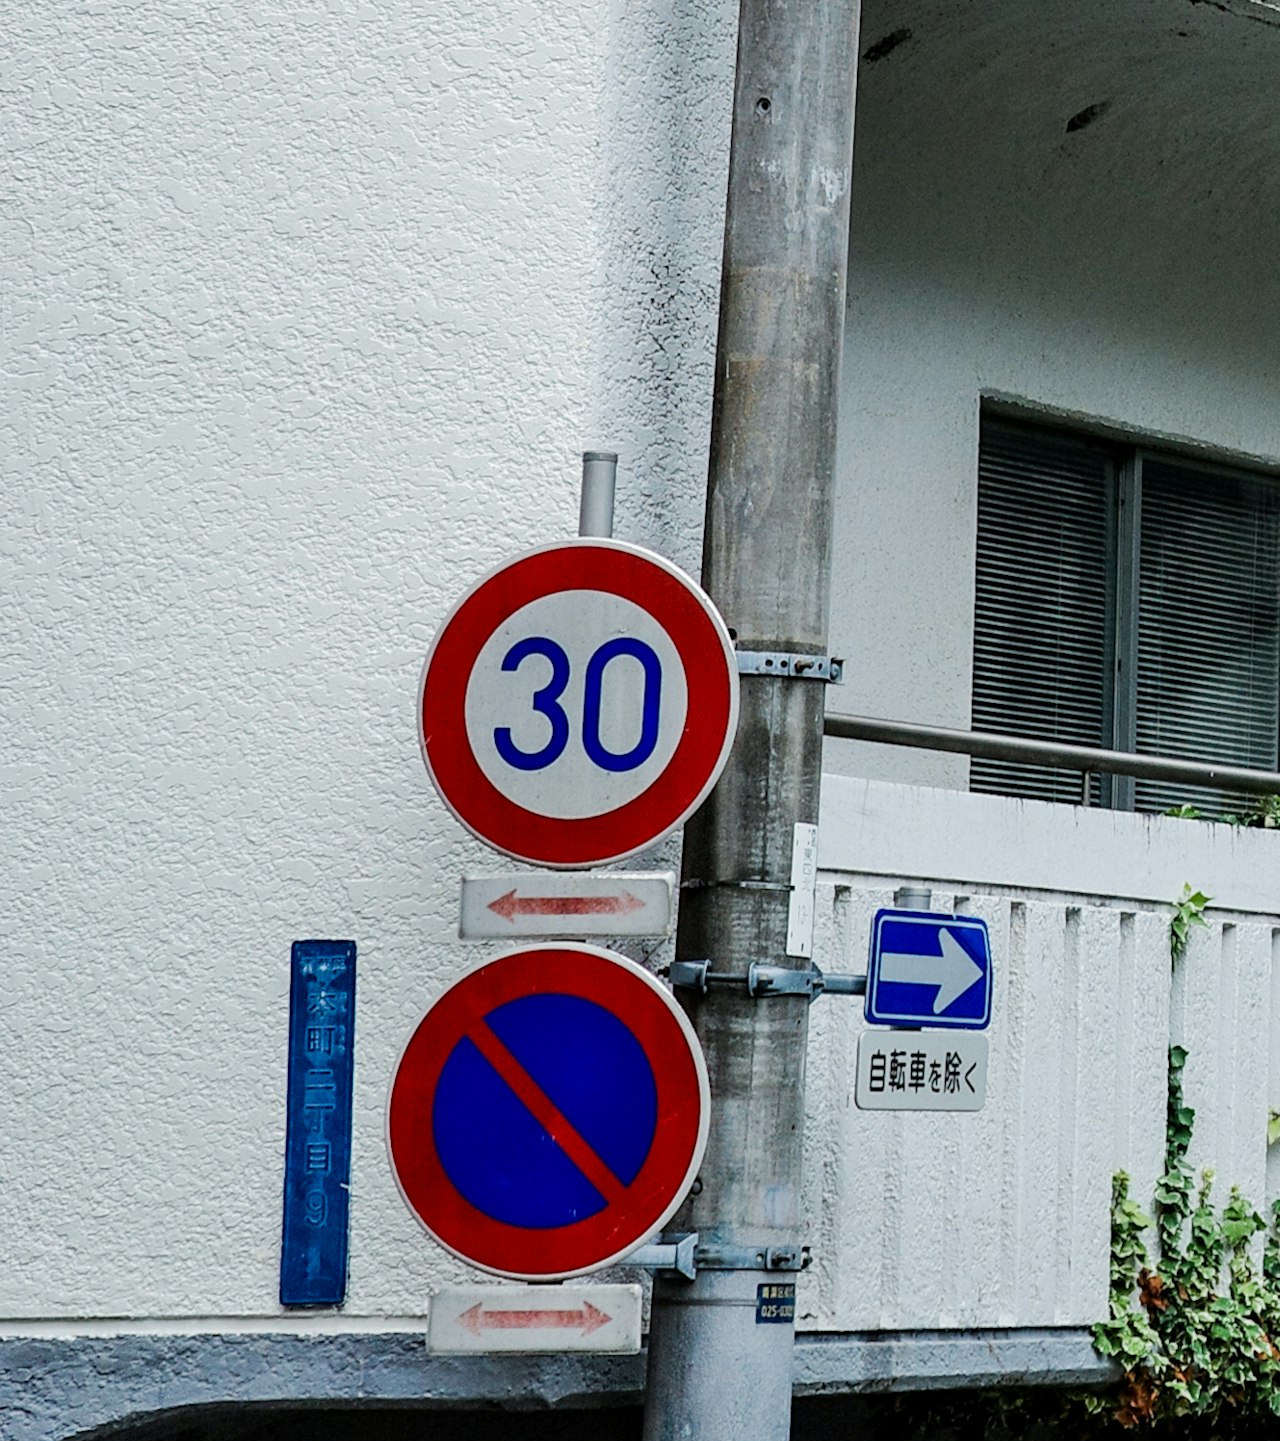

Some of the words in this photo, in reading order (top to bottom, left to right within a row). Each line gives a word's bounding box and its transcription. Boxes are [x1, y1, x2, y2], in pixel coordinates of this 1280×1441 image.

[494, 635, 663, 773] 30
[869, 1048, 977, 1094] 自転車を除く
